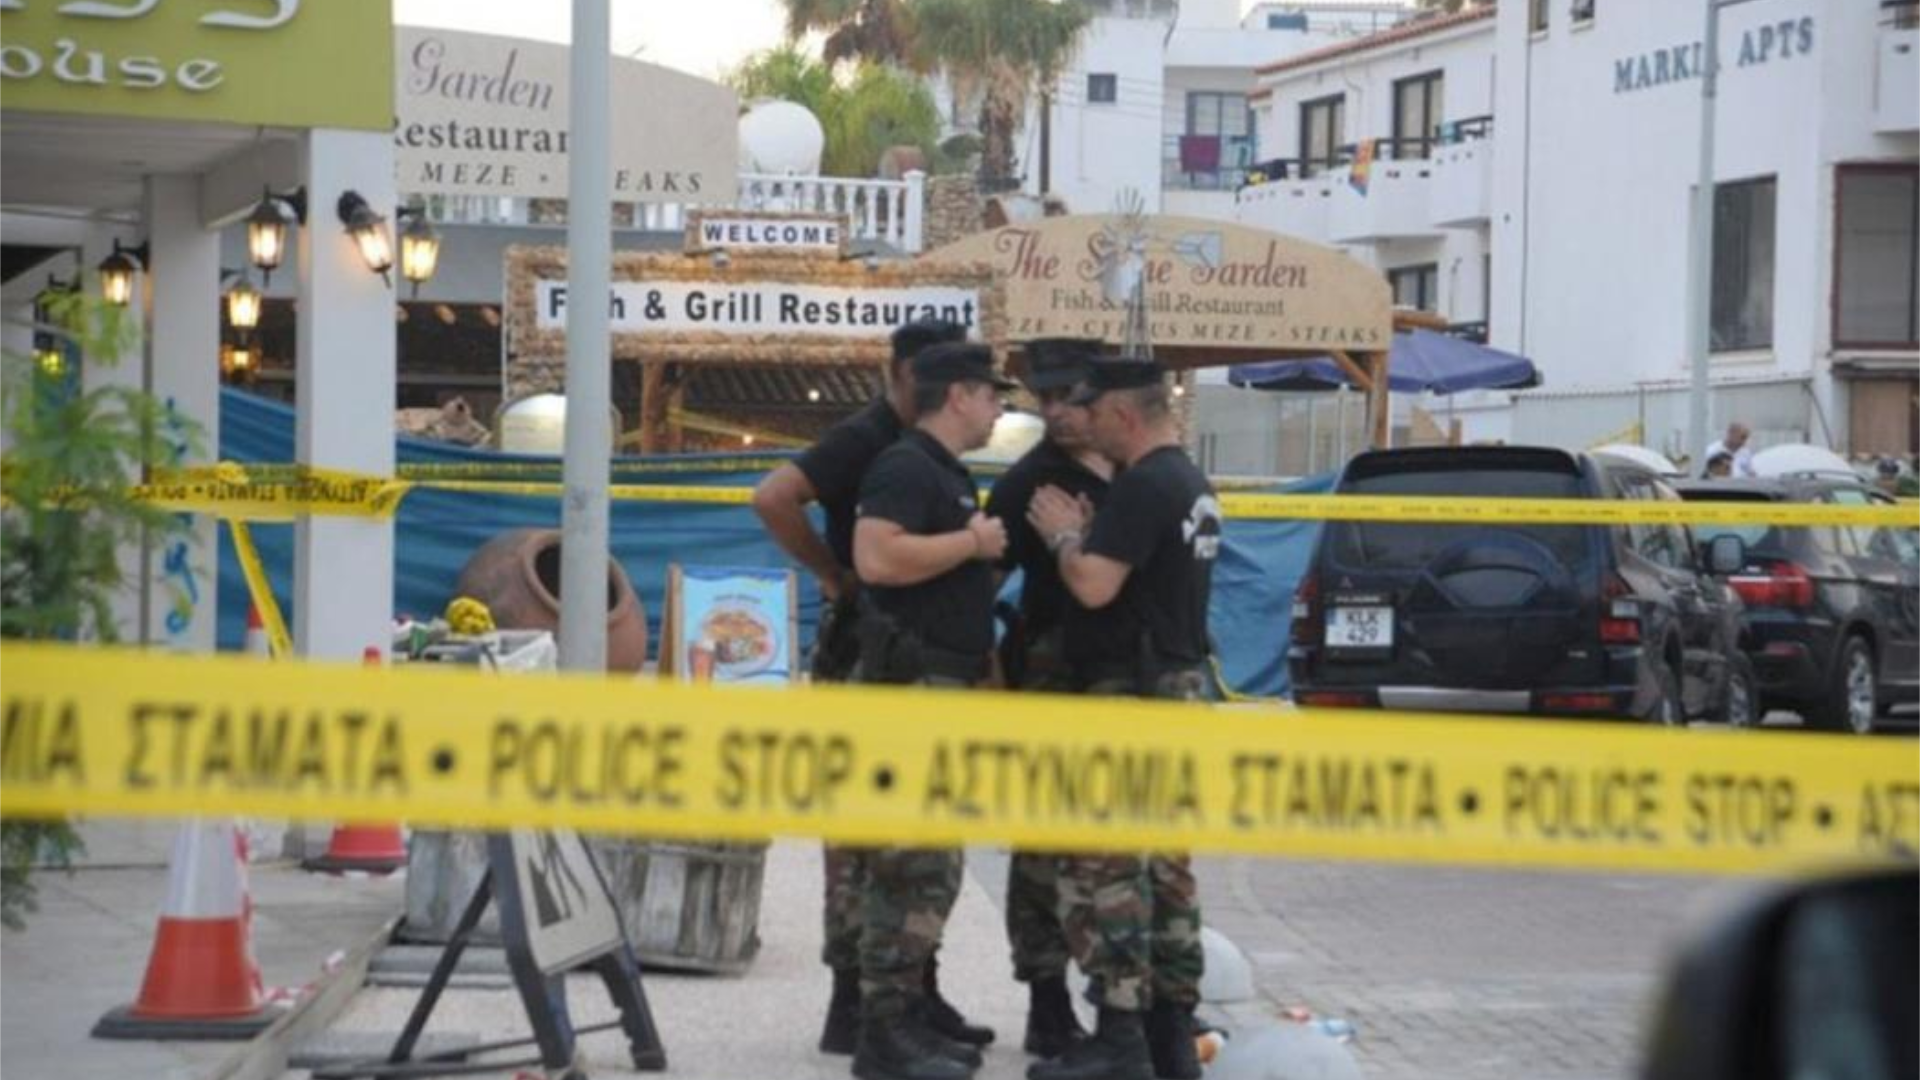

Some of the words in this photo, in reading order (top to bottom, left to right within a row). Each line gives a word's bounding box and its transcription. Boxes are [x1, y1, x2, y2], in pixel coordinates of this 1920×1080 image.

[0, 38, 224, 90] ouse
[408, 37, 553, 111] Garden
[1613, 41, 1722, 94] MARKI
[1736, 16, 1815, 68] APTS
[394, 116, 570, 153] estaura
[420, 161, 518, 186] MEZE
[613, 170, 702, 193] EAKS
[703, 223, 838, 244] WELCOME
[994, 228, 1060, 280] The
[1077, 231, 1173, 284] Sne
[549, 287, 625, 319] Fh
[644, 289, 667, 320] &
[685, 290, 762, 322] Grill
[780, 293, 974, 327] Restaurant
[1051, 288, 1094, 312] Fish
[1174, 292, 1285, 316] Restaurant
[1189, 324, 1254, 341] MEZE
[1290, 326, 1380, 343] STEAKS
[1347, 625, 1378, 642] 429
[125, 702, 410, 793] ΣΤΑΜΑΤΑ
[488, 716, 687, 808] POLICE
[716, 728, 855, 813] STOP
[922, 741, 1203, 823] ΑΣΤΥΝΟΜΙΑ
[1229, 752, 1442, 832] ΣΤΑΜΑΤΑ
[1503, 765, 1661, 844] POLICE
[1684, 772, 1796, 848] STOP
